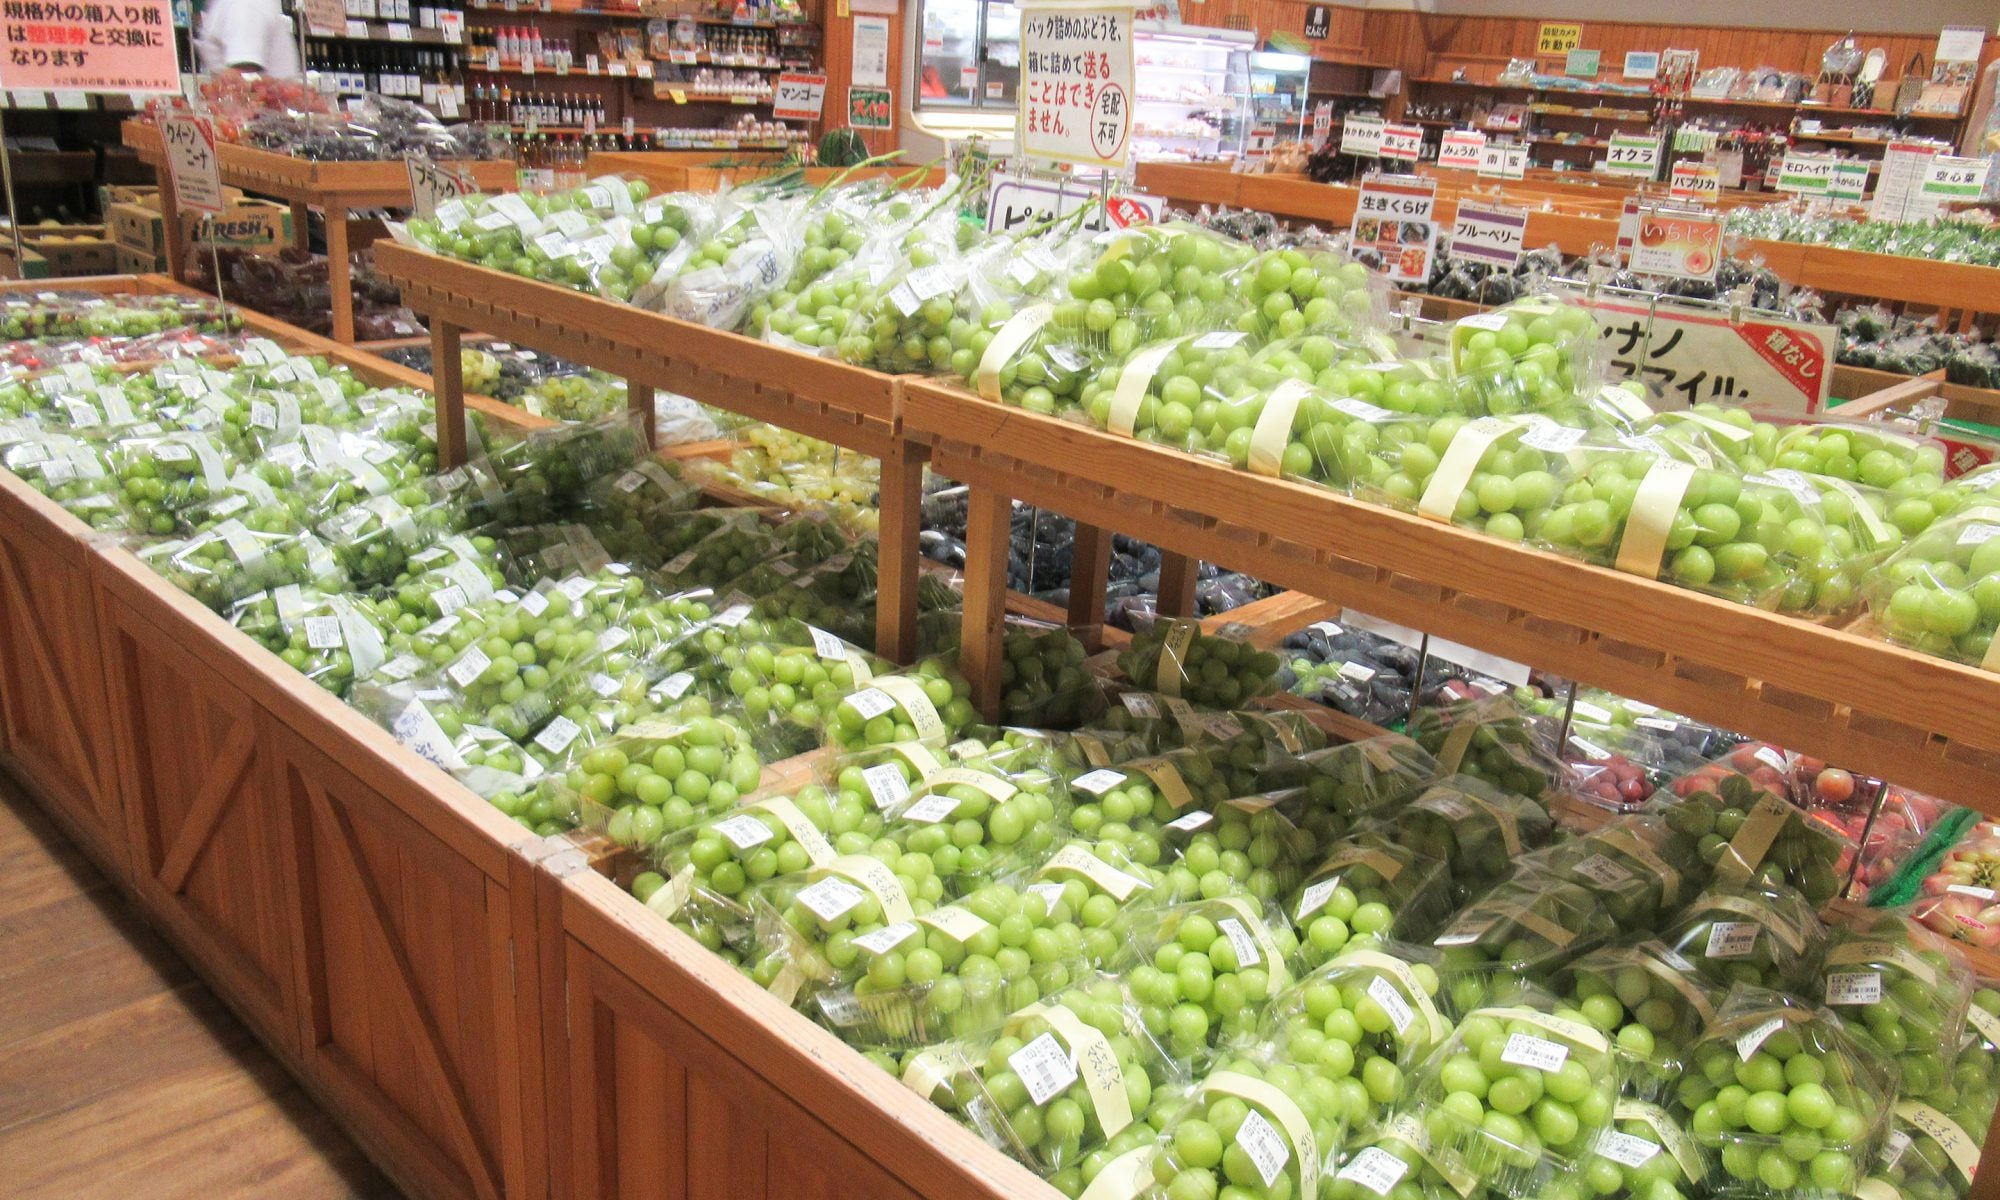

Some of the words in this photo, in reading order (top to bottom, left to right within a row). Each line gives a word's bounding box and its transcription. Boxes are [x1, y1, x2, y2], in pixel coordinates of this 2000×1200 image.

[4, 1, 162, 25] 規格外の箱入り桃
[7, 25, 164, 47] は整理券と交換に
[1028, 15, 1122, 41] パック詰めのぶどうを、
[1543, 27, 1577, 37] 防犯カメラ
[1540, 39, 1575, 51] 作動中
[11, 48, 89, 66] なります
[1028, 50, 1110, 80] 箱に詰めて送る
[780, 87, 820, 102] マンゴー
[1029, 80, 1095, 109] ことはでき
[1101, 91, 1121, 116] 宅配
[852, 99, 889, 119] スイカ
[1028, 107, 1070, 138] ません。
[1344, 126, 1381, 140] おかわかめ
[1097, 121, 1118, 146] 不可
[1384, 135, 1416, 149] 赤じそ
[185, 147, 208, 170] ニーナ
[1611, 148, 1653, 162] オクラ
[1785, 162, 1831, 175] モロヘイヤ
[1935, 170, 1977, 183] 空心菜
[1674, 176, 1716, 190] パプリカ
[1361, 195, 1430, 216] 生きくらげ
[1456, 222, 1521, 244] ブルーベリー
[1644, 222, 1715, 246] いちじく
[1765, 328, 1817, 378] 種なし
